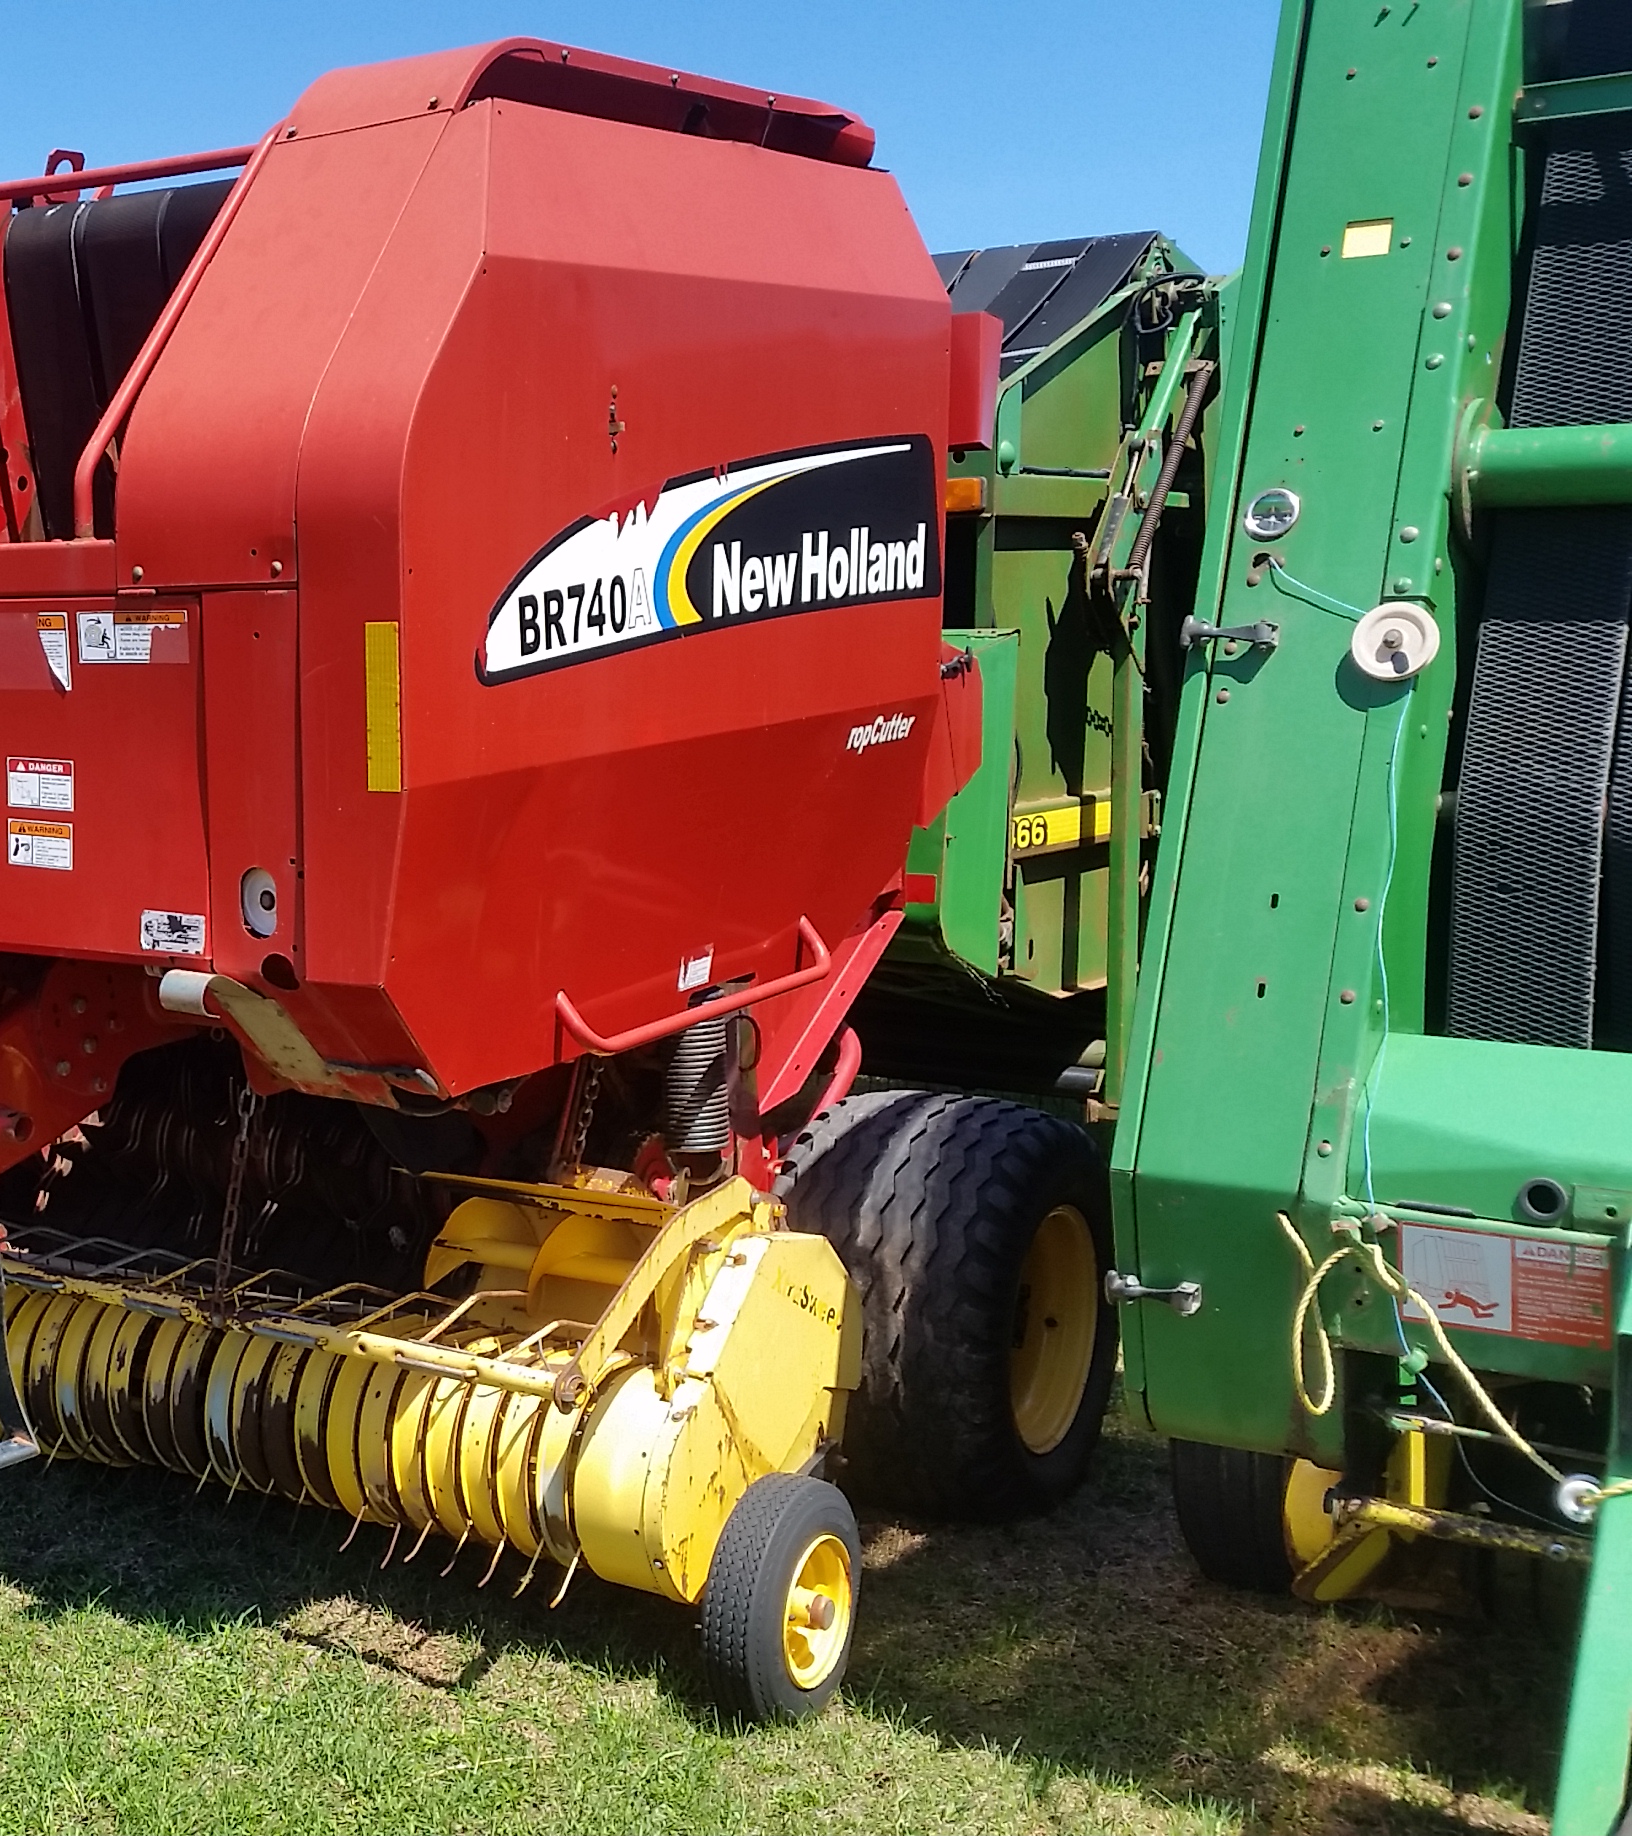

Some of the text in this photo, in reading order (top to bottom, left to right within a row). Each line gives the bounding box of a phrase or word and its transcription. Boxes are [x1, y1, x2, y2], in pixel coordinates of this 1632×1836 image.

[711, 522, 927, 618] New Holland
[518, 567, 653, 657] BR740A
[135, 614, 170, 622] WARNING
[28, 763, 64, 773] DANGER
[27, 825, 63, 835] WARNING
